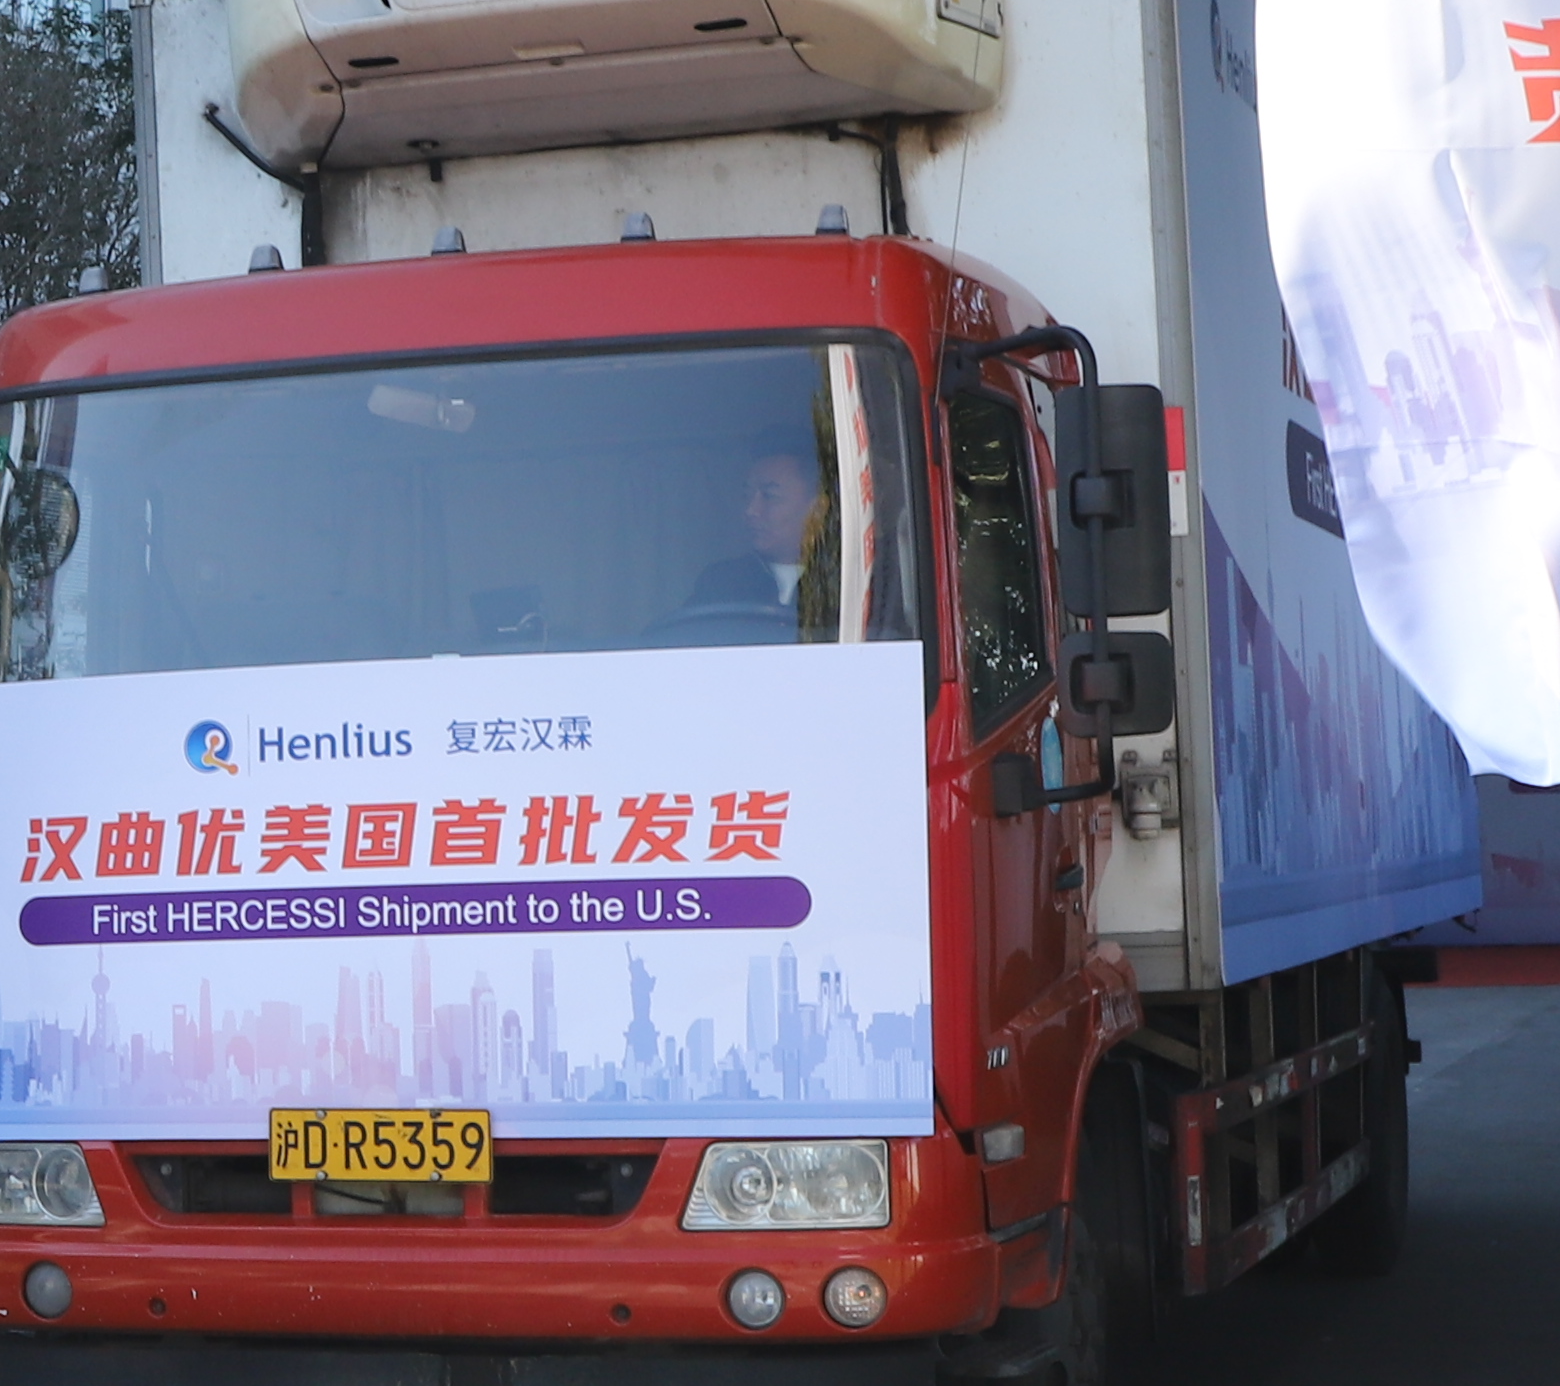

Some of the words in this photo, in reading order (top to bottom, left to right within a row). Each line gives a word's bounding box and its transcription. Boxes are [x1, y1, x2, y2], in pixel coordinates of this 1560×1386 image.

[257, 721, 414, 763] Henlius
[445, 715, 593, 756] 复宏汉霖
[20, 790, 791, 883] 汉曲优美国首批发货
[91, 903, 159, 935] First
[166, 896, 347, 933] HERCESSI
[356, 894, 518, 934] Shipment
[526, 893, 560, 924] to
[570, 890, 625, 923] the
[636, 888, 712, 922] U.S.
[276, 1120, 485, 1171] 沪D·R5359
